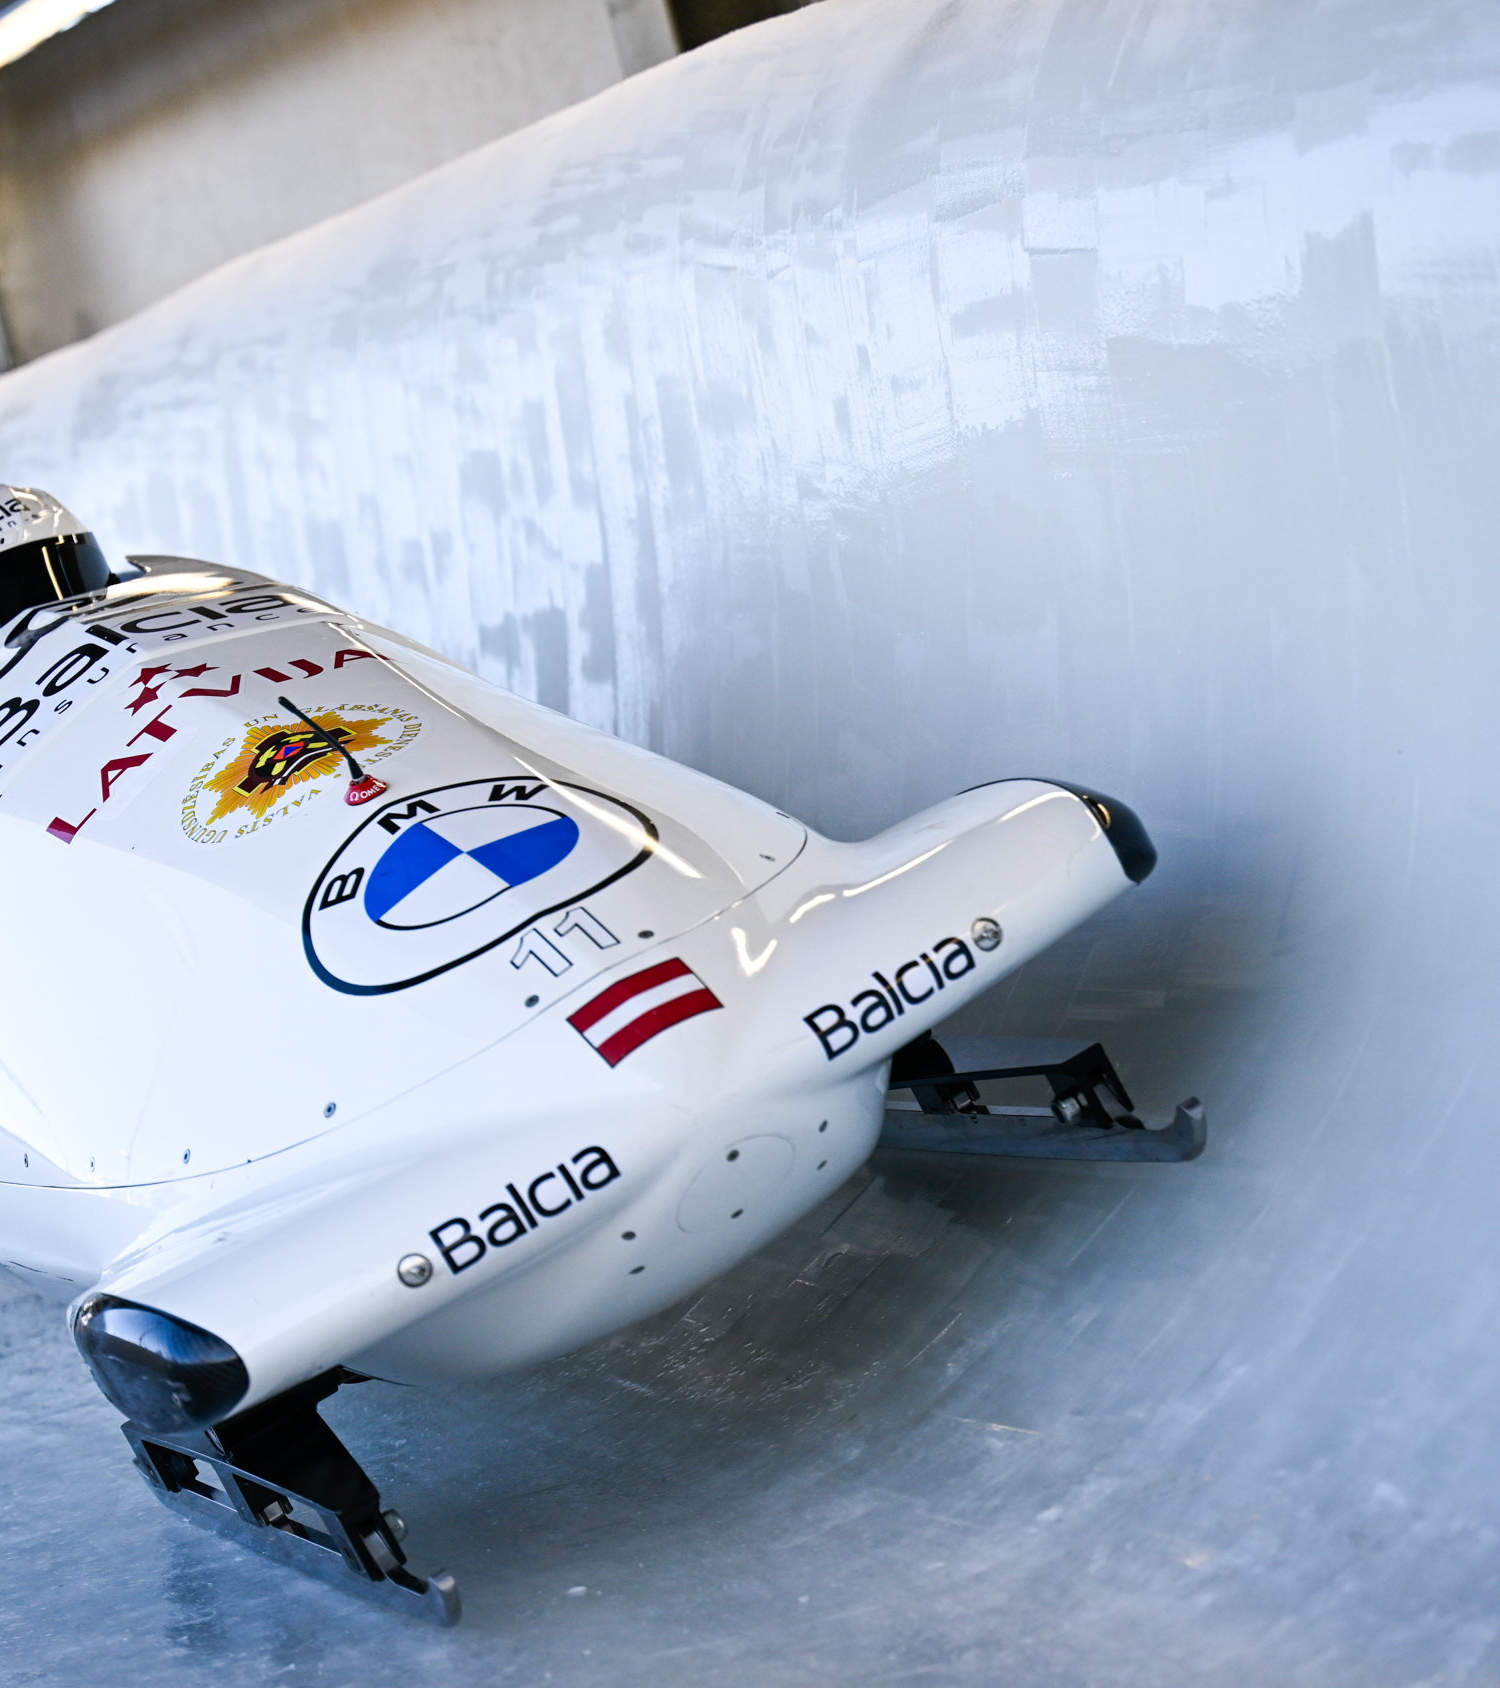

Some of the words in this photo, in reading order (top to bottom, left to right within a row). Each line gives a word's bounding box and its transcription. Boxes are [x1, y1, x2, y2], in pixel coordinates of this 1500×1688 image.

[46, 648, 391, 845] LATVIJA
[242, 713, 279, 729] UN
[234, 788, 322, 839] VALSTS
[319, 783, 549, 911] BMW
[510, 906, 620, 977] 11
[803, 936, 976, 1061] Balcia
[428, 1145, 621, 1275] Balcia
